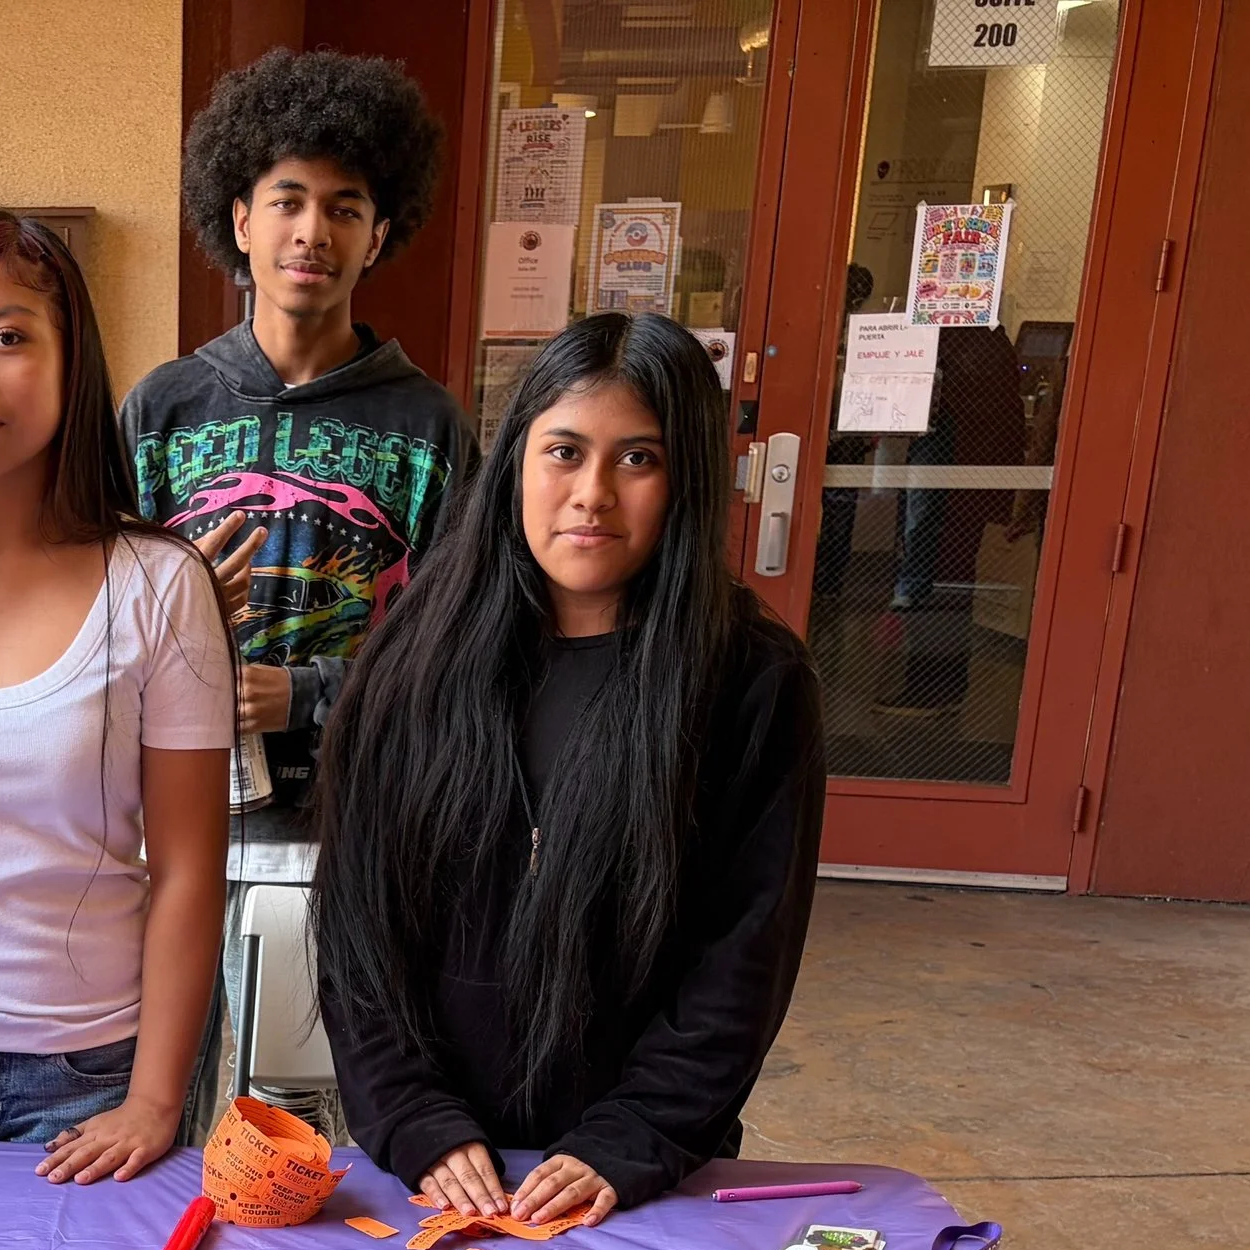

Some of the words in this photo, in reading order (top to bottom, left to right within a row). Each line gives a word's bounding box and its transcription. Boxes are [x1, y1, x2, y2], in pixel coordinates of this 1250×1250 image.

[973, 22, 1018, 48] 200
[526, 133, 552, 143] RISE
[942, 230, 982, 245] FAIR
[860, 324, 877, 332] PARA
[878, 324, 899, 332] ABRIR
[857, 351, 890, 360] EMPUJE
[904, 350, 925, 358] JALE
[240, 1126, 279, 1159] TICKET
[225, 1156, 257, 1183] COUPON
[226, 1150, 244, 1167] KEEP
[244, 1164, 264, 1180] THIS
[287, 1159, 326, 1182] TICKET
[271, 1181, 293, 1196] KEEP
[272, 1189, 305, 1205] COUPON
[238, 1202, 264, 1210] KEEP
